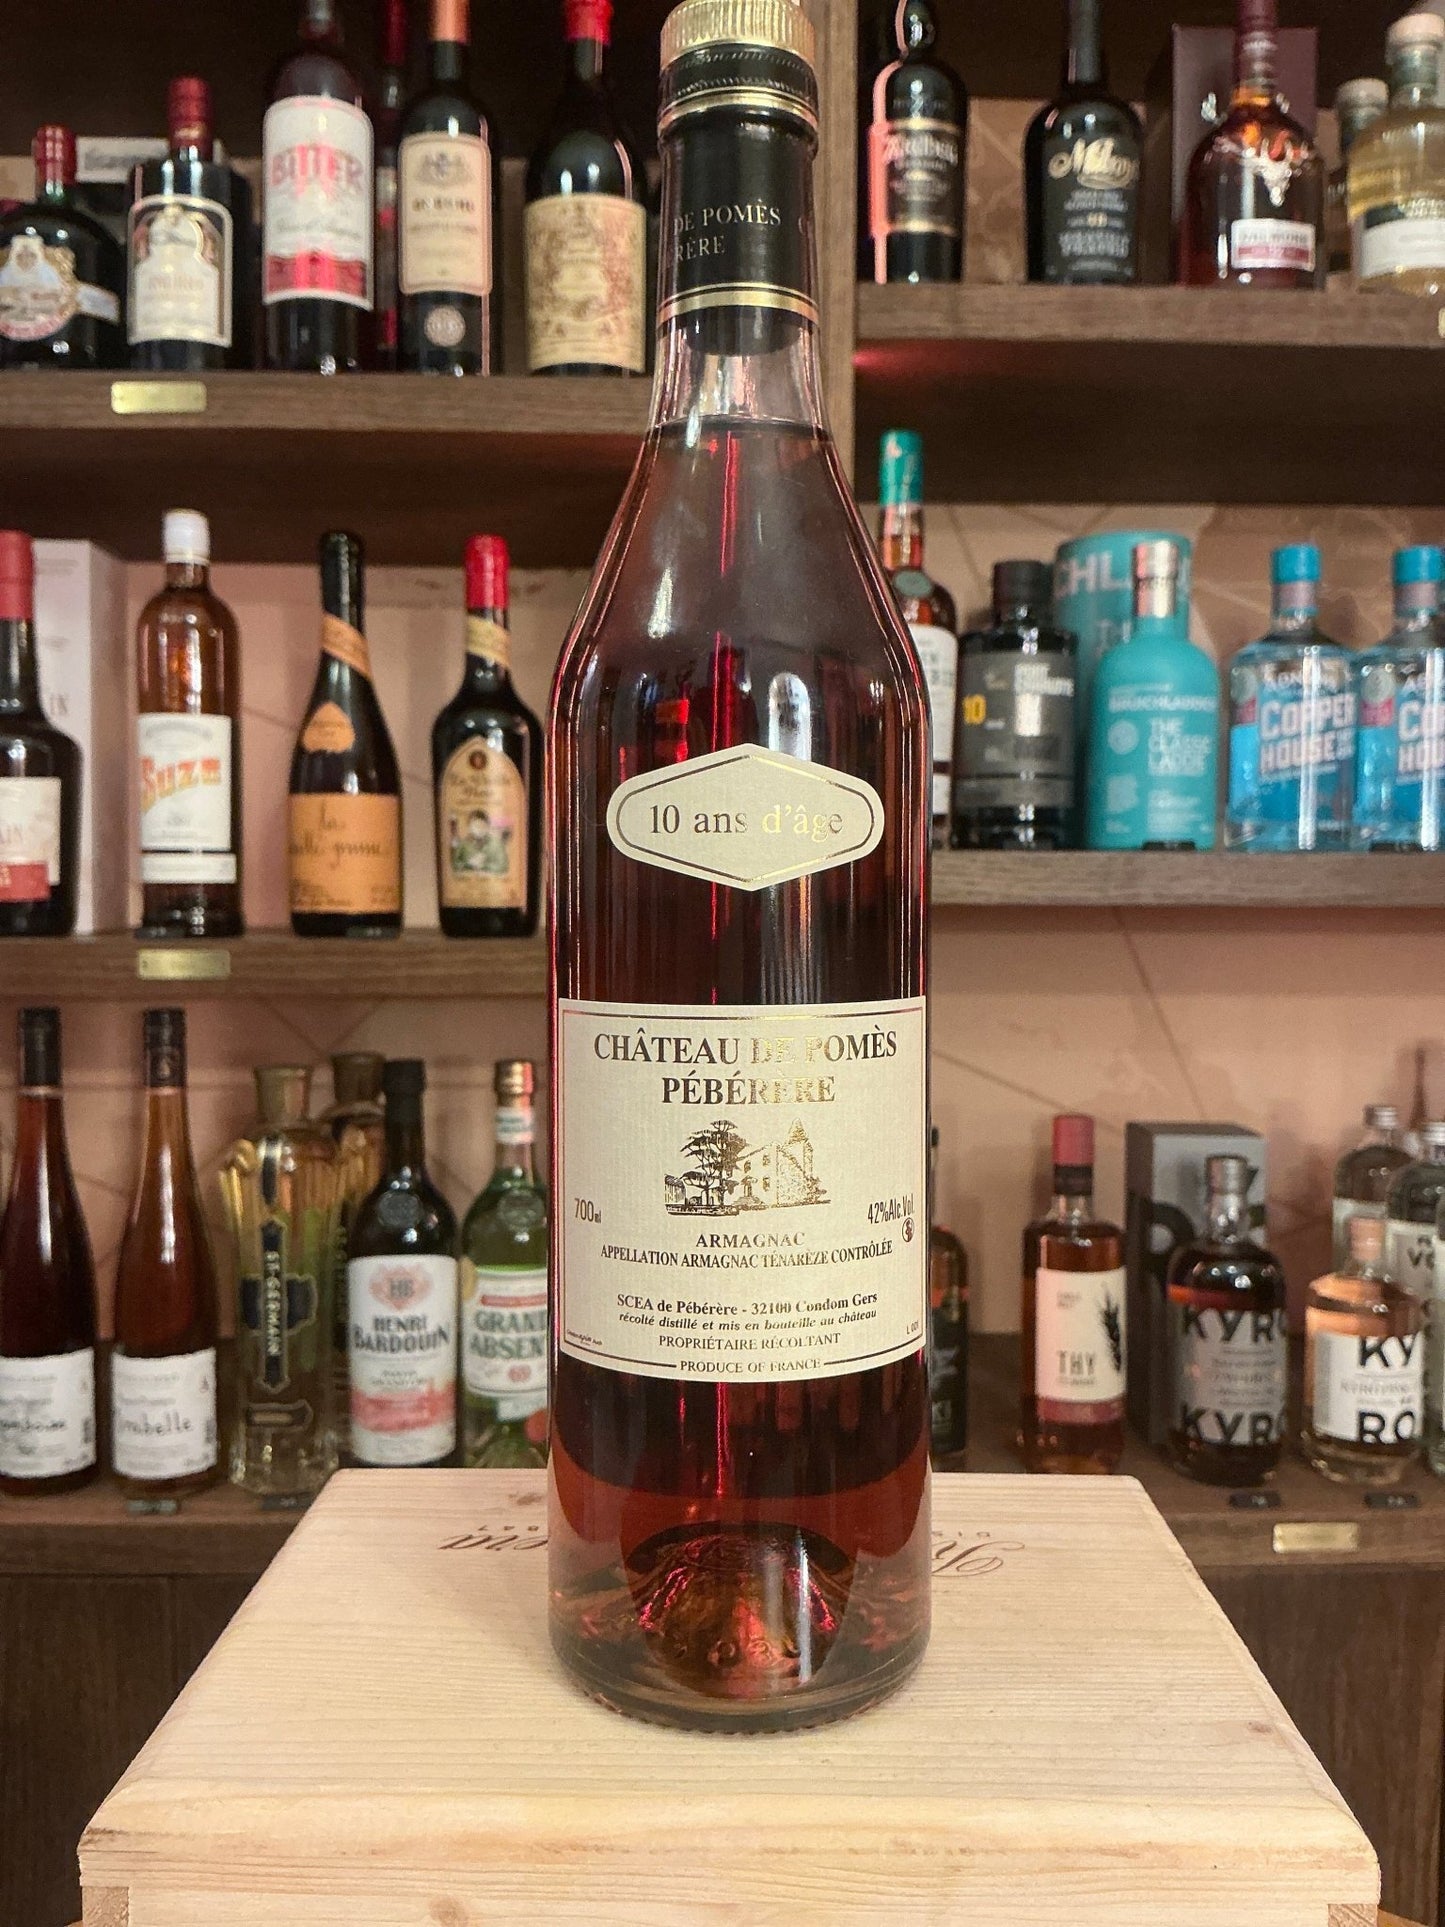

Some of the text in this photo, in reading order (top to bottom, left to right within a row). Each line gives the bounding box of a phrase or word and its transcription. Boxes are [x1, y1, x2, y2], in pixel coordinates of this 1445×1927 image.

[271, 144, 364, 194] BITTER
[702, 199, 782, 228] POMÈS
[1261, 693, 1356, 741] COPPER
[1261, 731, 1336, 774] HOUSE
[650, 804, 843, 843] 10 ans d'âge
[594, 1024, 897, 1065] CHÂTEAU DE POMÈS
[662, 1069, 835, 1105] PÉBÉRÈRE
[601, 1244, 678, 1267] APPELLATION
[681, 1253, 759, 1269] ARMAGNAC
[831, 1237, 893, 1264] CONTRÔLÉE
[695, 1232, 805, 1249] ARMAGNAC
[617, 1293, 654, 1311] SCEA
[657, 1300, 673, 1312] de
[677, 1300, 738, 1316] Pébérère
[751, 1302, 792, 1316] 32100
[796, 1298, 849, 1313] Condom
[852, 1292, 878, 1307] Gers
[373, 1315, 428, 1332] HENRI
[619, 1310, 877, 1331] récolté distillé et mis en bouteille au château
[351, 1322, 450, 1354] BARDOUIN
[659, 1333, 841, 1350] PROPRIÉTAIRE RÉCOLTANT
[680, 1359, 821, 1373] PRODUCE OF FRANCE
[1057, 1350, 1097, 1376] THY
